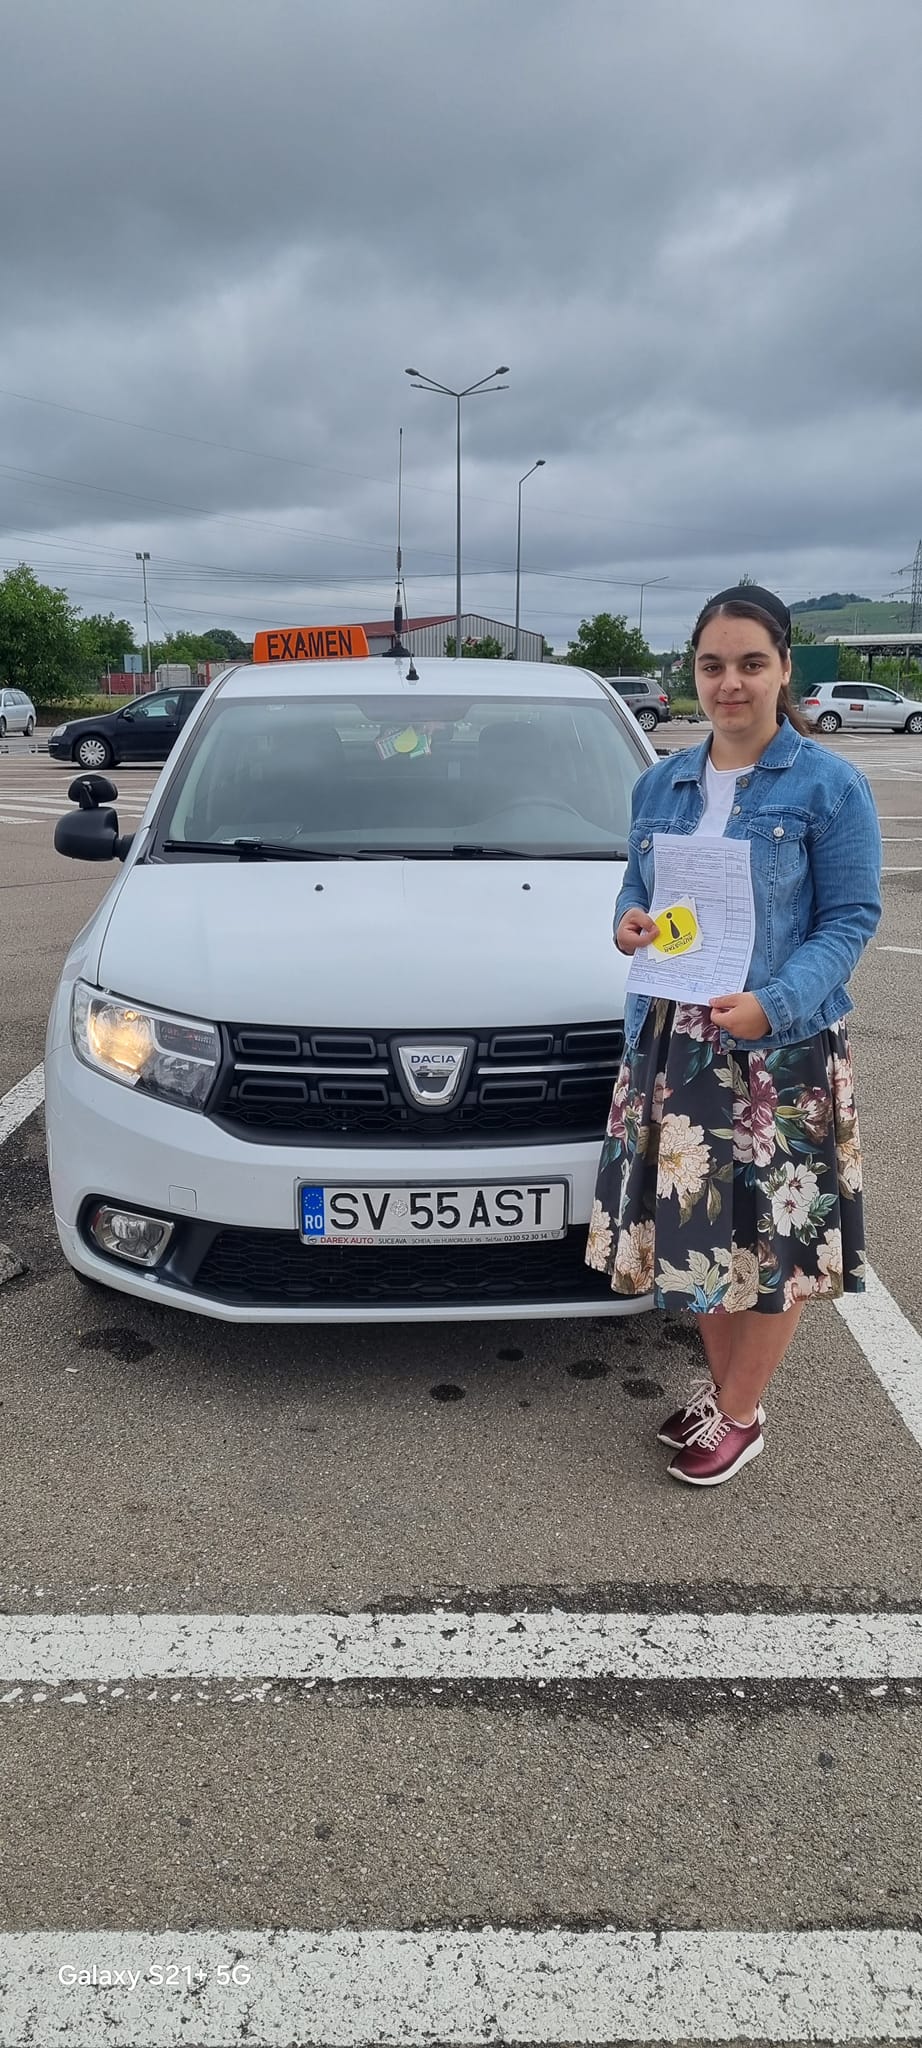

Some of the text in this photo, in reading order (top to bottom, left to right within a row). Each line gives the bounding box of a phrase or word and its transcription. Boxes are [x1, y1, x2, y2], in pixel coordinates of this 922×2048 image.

[267, 630, 353, 660] EXAMEN
[411, 1055, 456, 1064] DACIA
[329, 1187, 551, 1231] SV 55 AST
[304, 1214, 323, 1230] RO
[320, 1236, 349, 1244] DAREX
[350, 1236, 374, 1244] AUTO
[521, 1233, 530, 1241] 52
